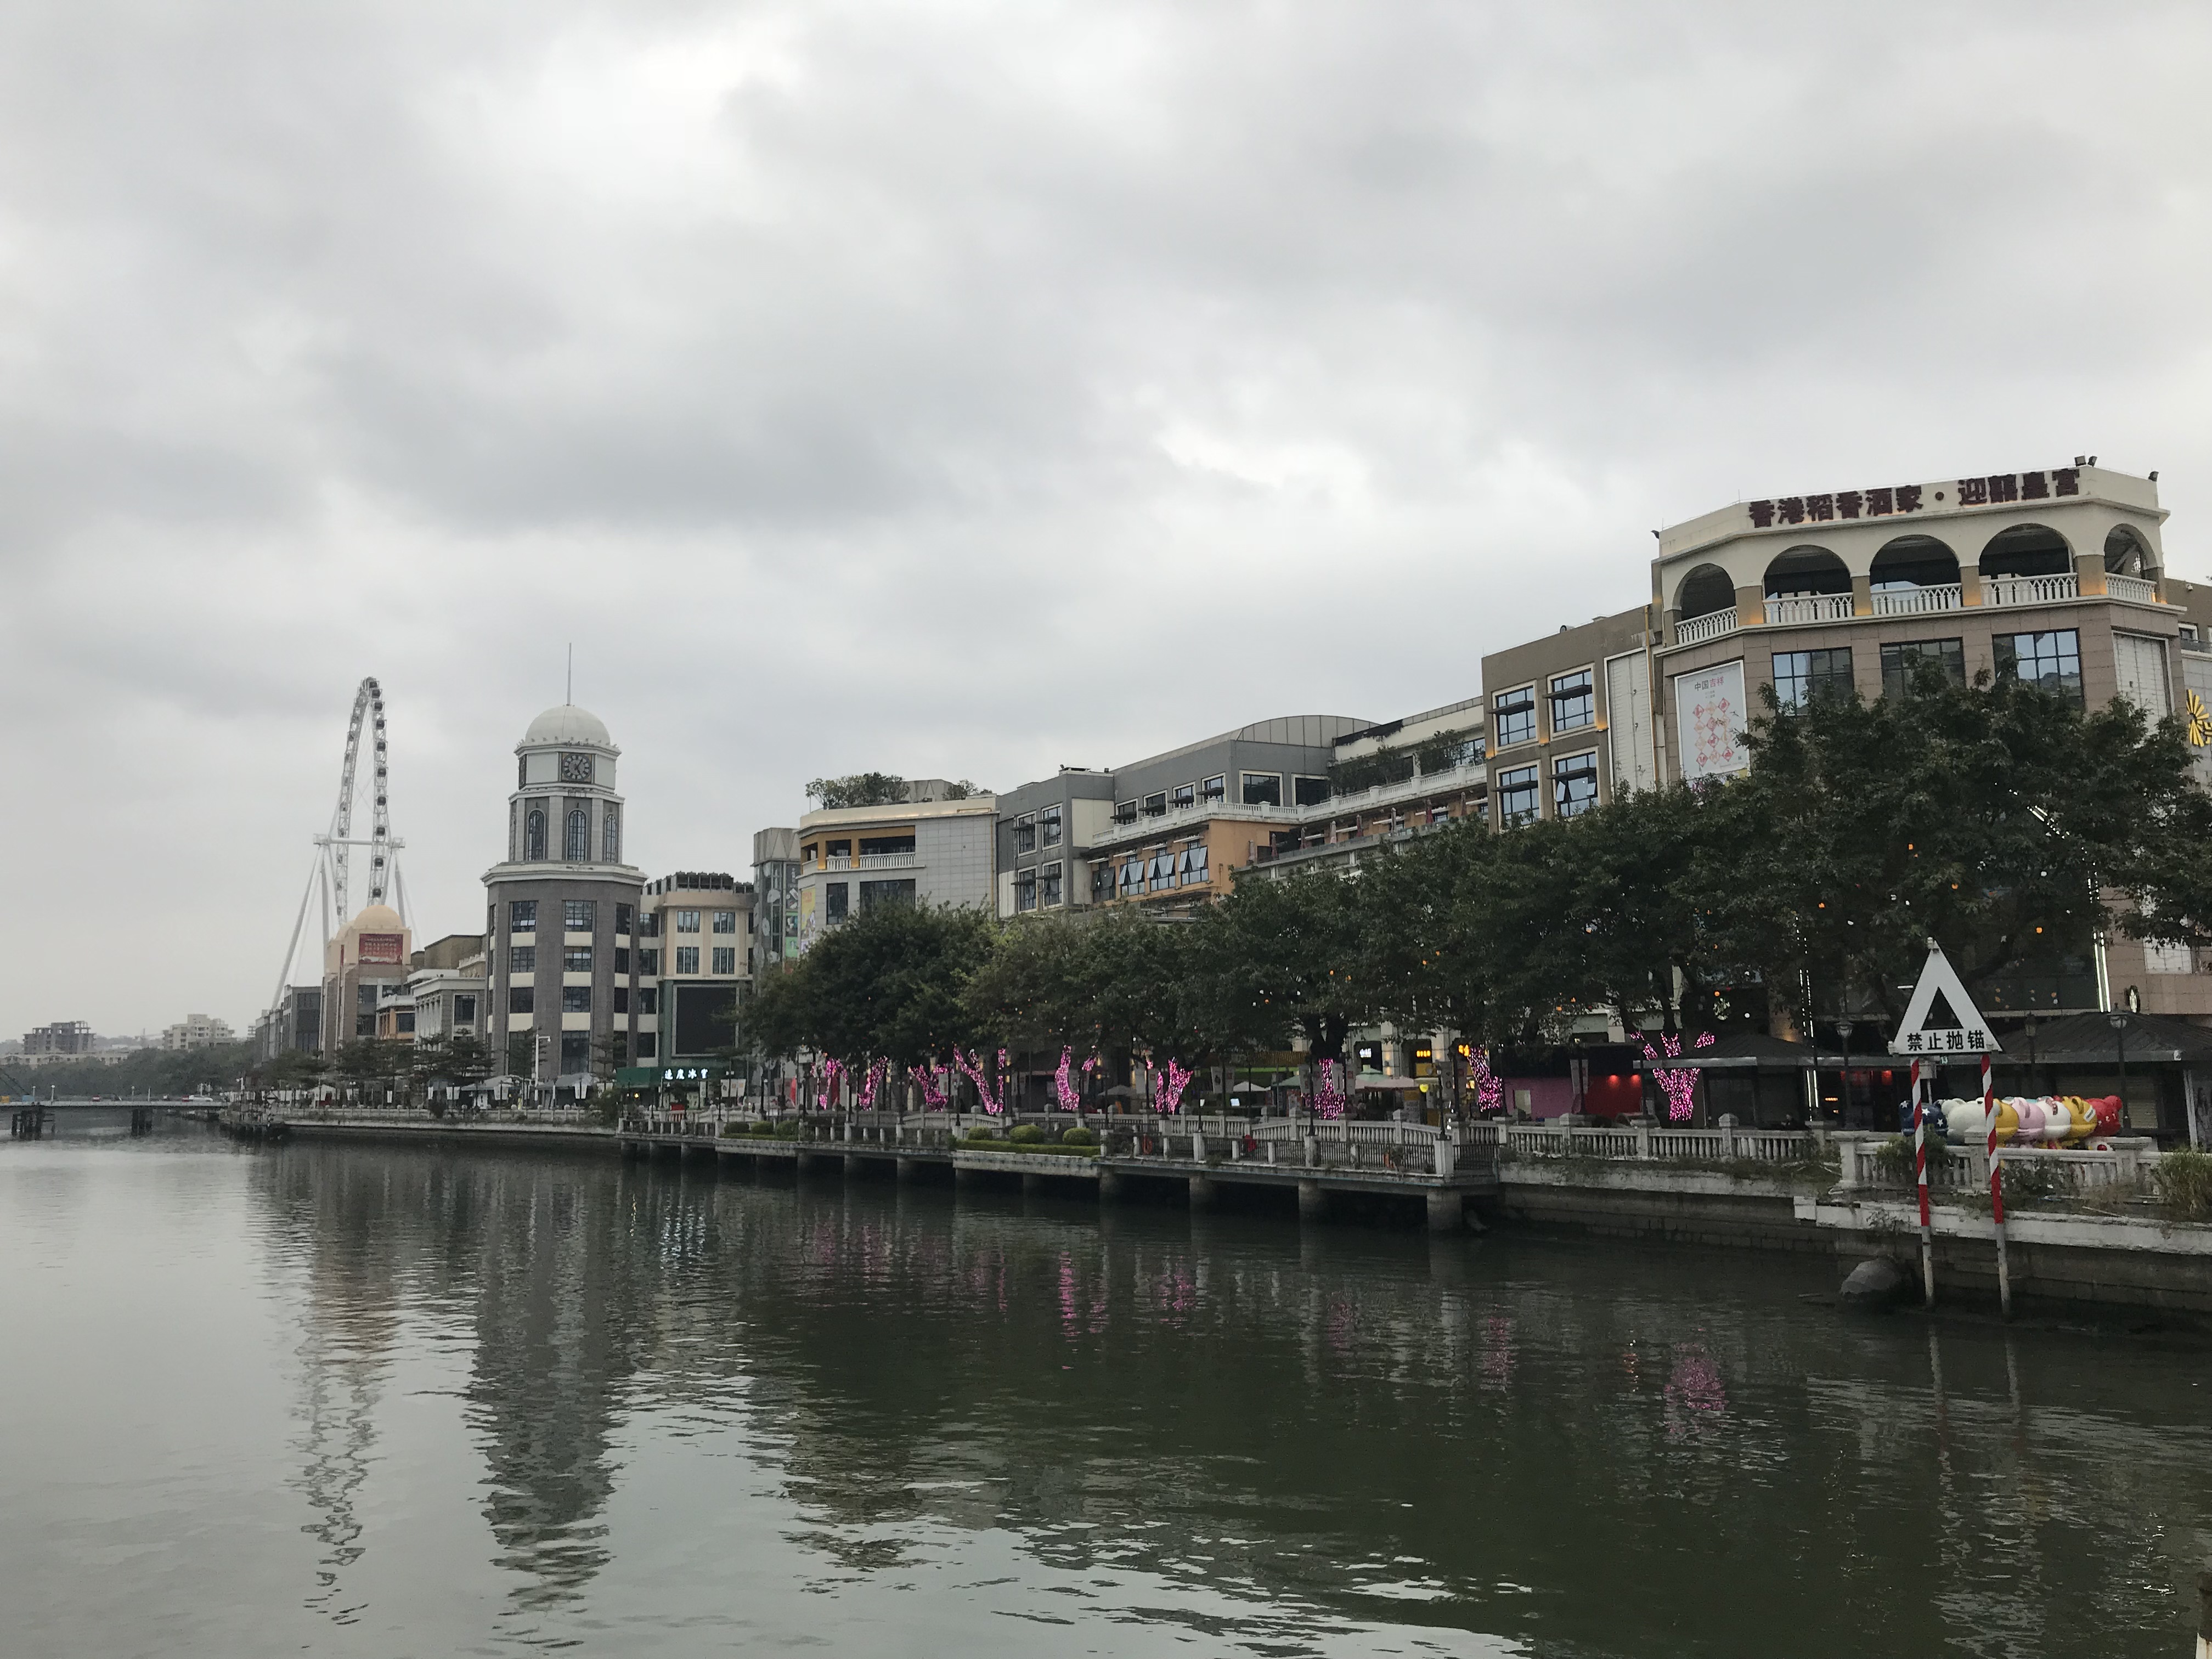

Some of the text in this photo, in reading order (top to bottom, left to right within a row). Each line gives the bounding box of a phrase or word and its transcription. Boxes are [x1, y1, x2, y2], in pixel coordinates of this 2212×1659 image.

[1695, 676, 1724, 691] 中国吉祥
[1907, 1029, 1985, 1051] 禁止抛锚
